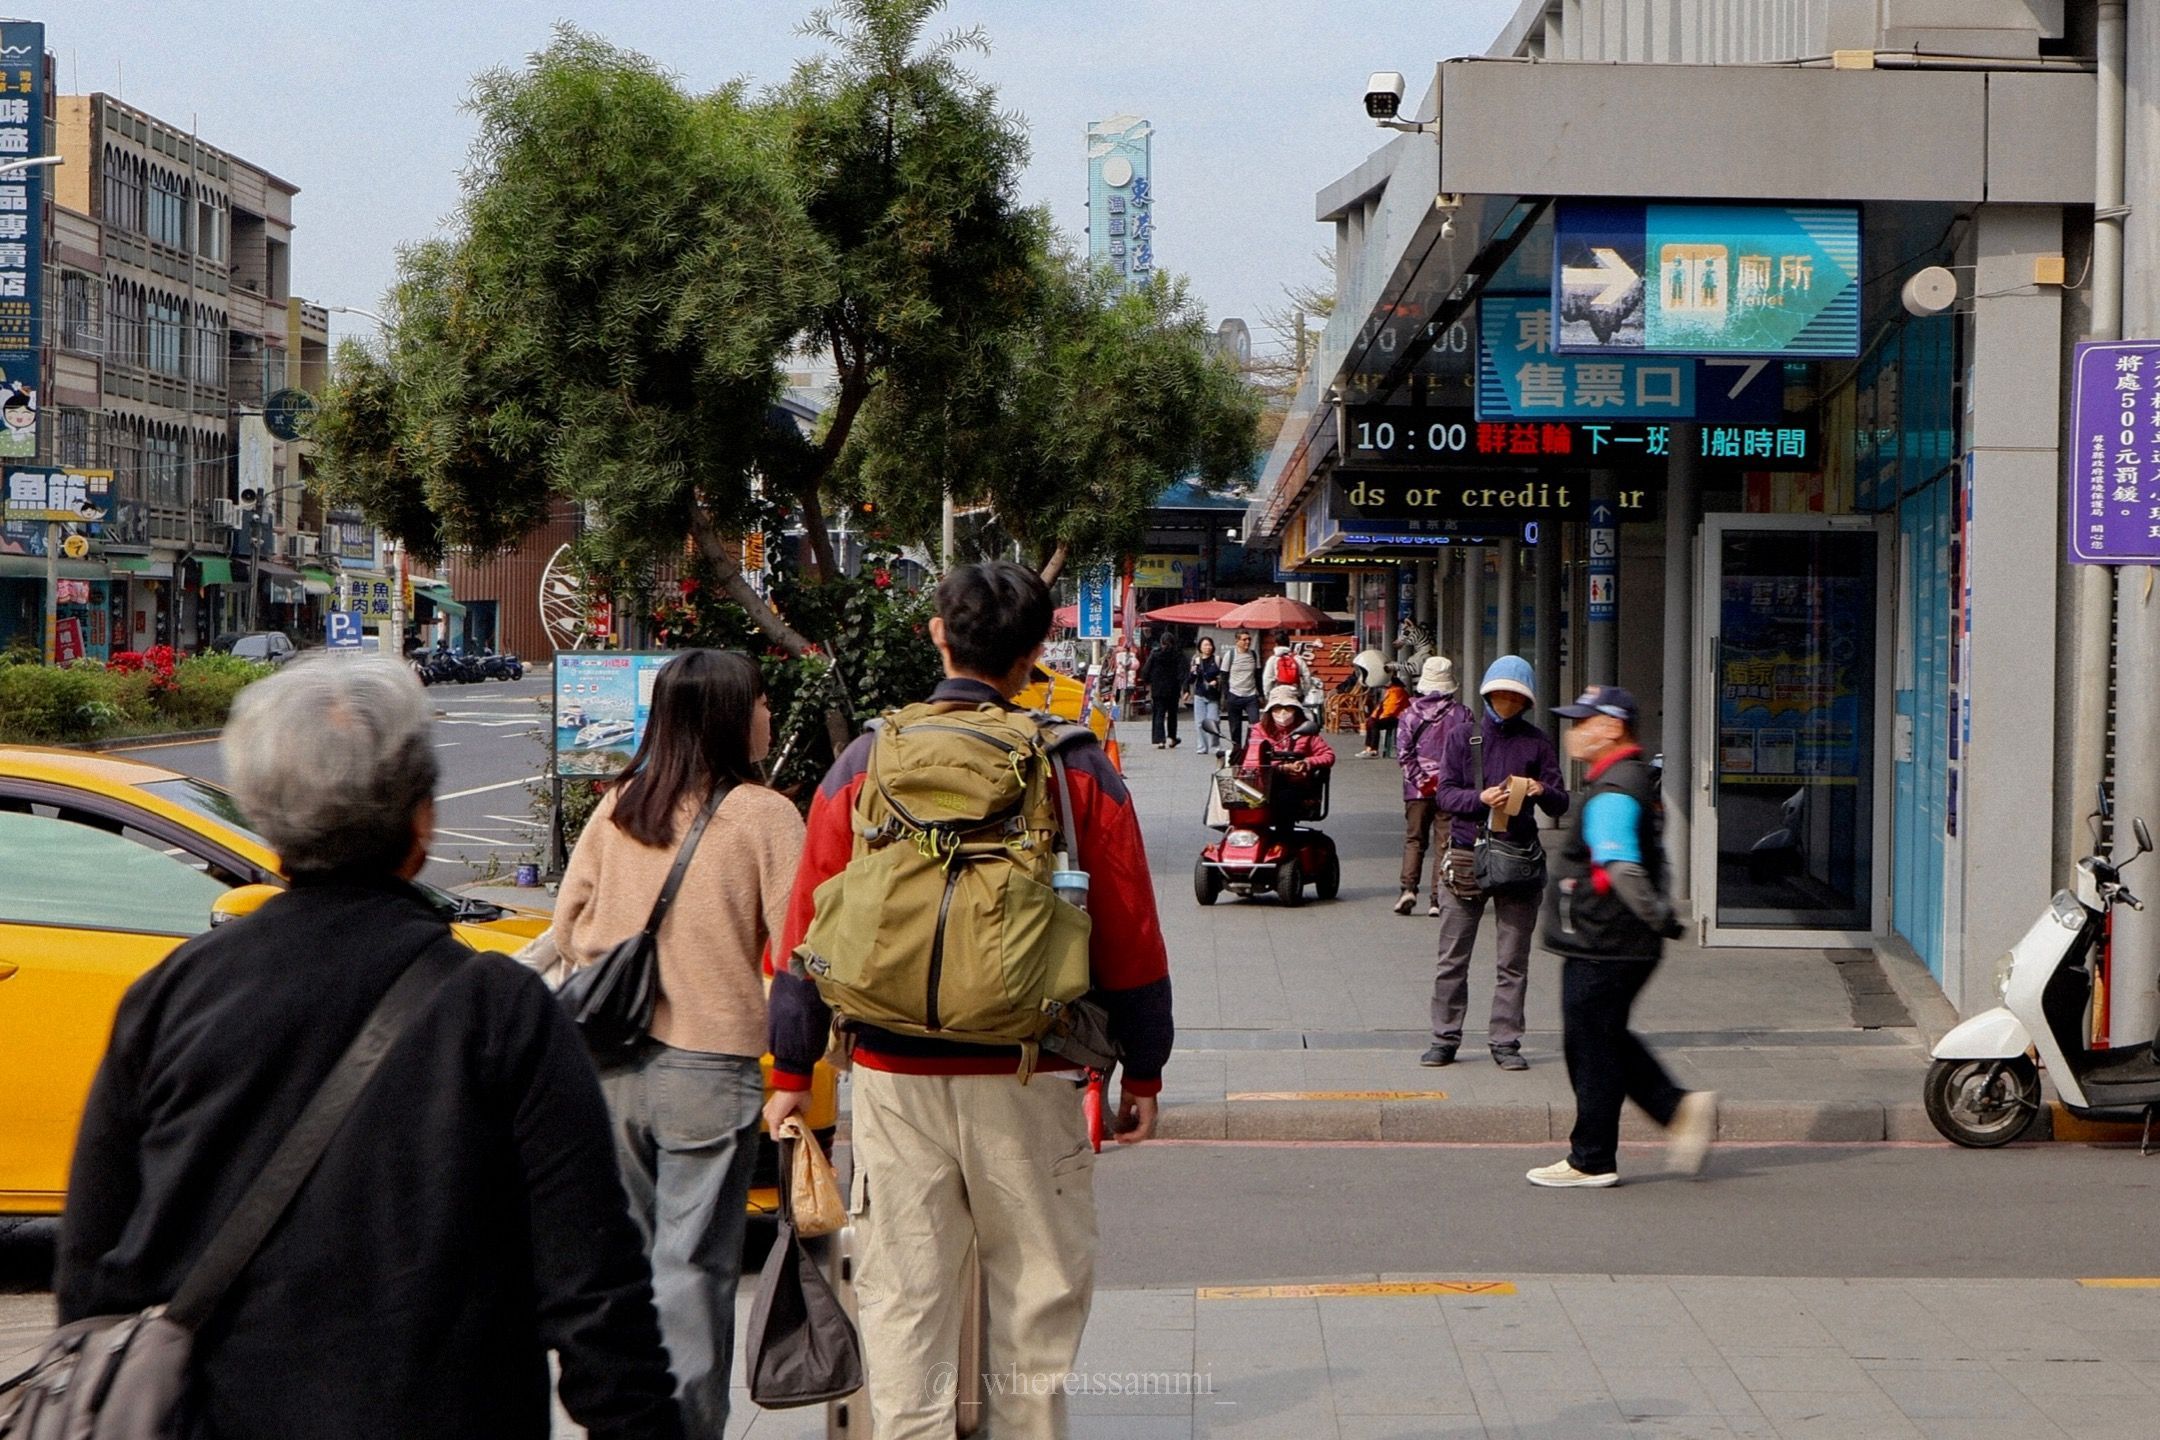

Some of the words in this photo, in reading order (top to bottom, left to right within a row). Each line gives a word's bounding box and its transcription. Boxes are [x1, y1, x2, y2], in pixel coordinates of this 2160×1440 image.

[1738, 255, 1814, 291] 廁所
[1516, 362, 1681, 408] 售票口
[1357, 422, 1467, 451] 10:00
[1477, 423, 1572, 454] 群益輪
[1582, 425, 1806, 458] 下一班船時間
[2112, 355, 2144, 517] 將處500元罰鍰。
[1405, 488, 1441, 506] or
[1461, 483, 1571, 507] credit
[331, 613, 350, 639] P
